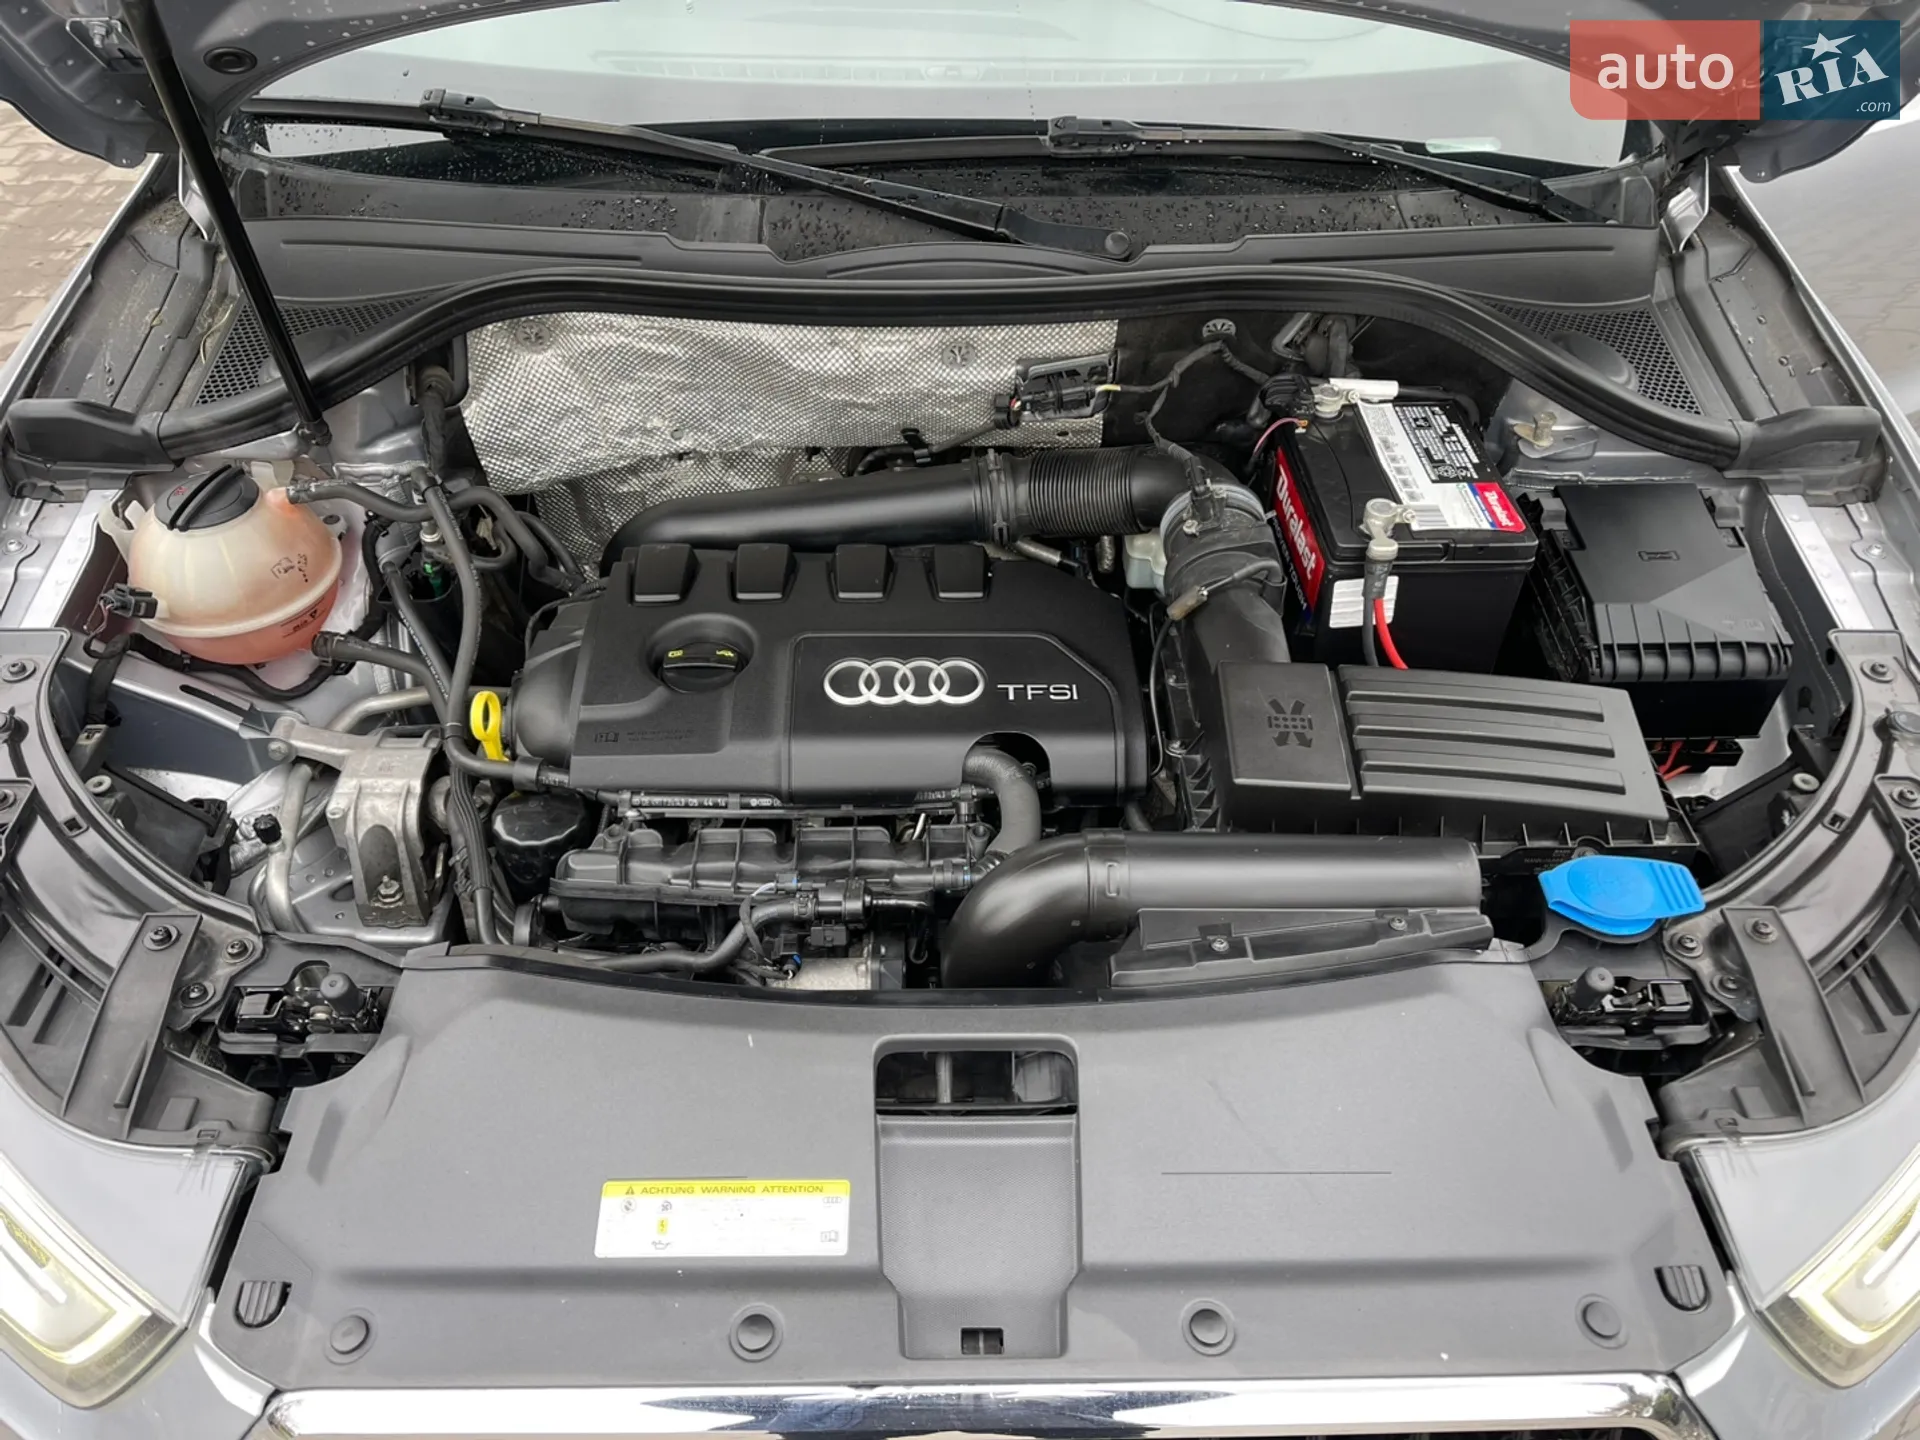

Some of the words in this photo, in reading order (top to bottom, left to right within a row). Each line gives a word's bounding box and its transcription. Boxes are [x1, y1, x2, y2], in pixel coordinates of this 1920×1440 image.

[1276, 463, 1317, 580] Duralast
[1483, 490, 1515, 527] Duralast
[997, 684, 1078, 700] TFSI
[640, 1186, 695, 1195] ACHTUNG
[701, 1185, 756, 1194] WARNING
[762, 1185, 824, 1194] ATTENTION
